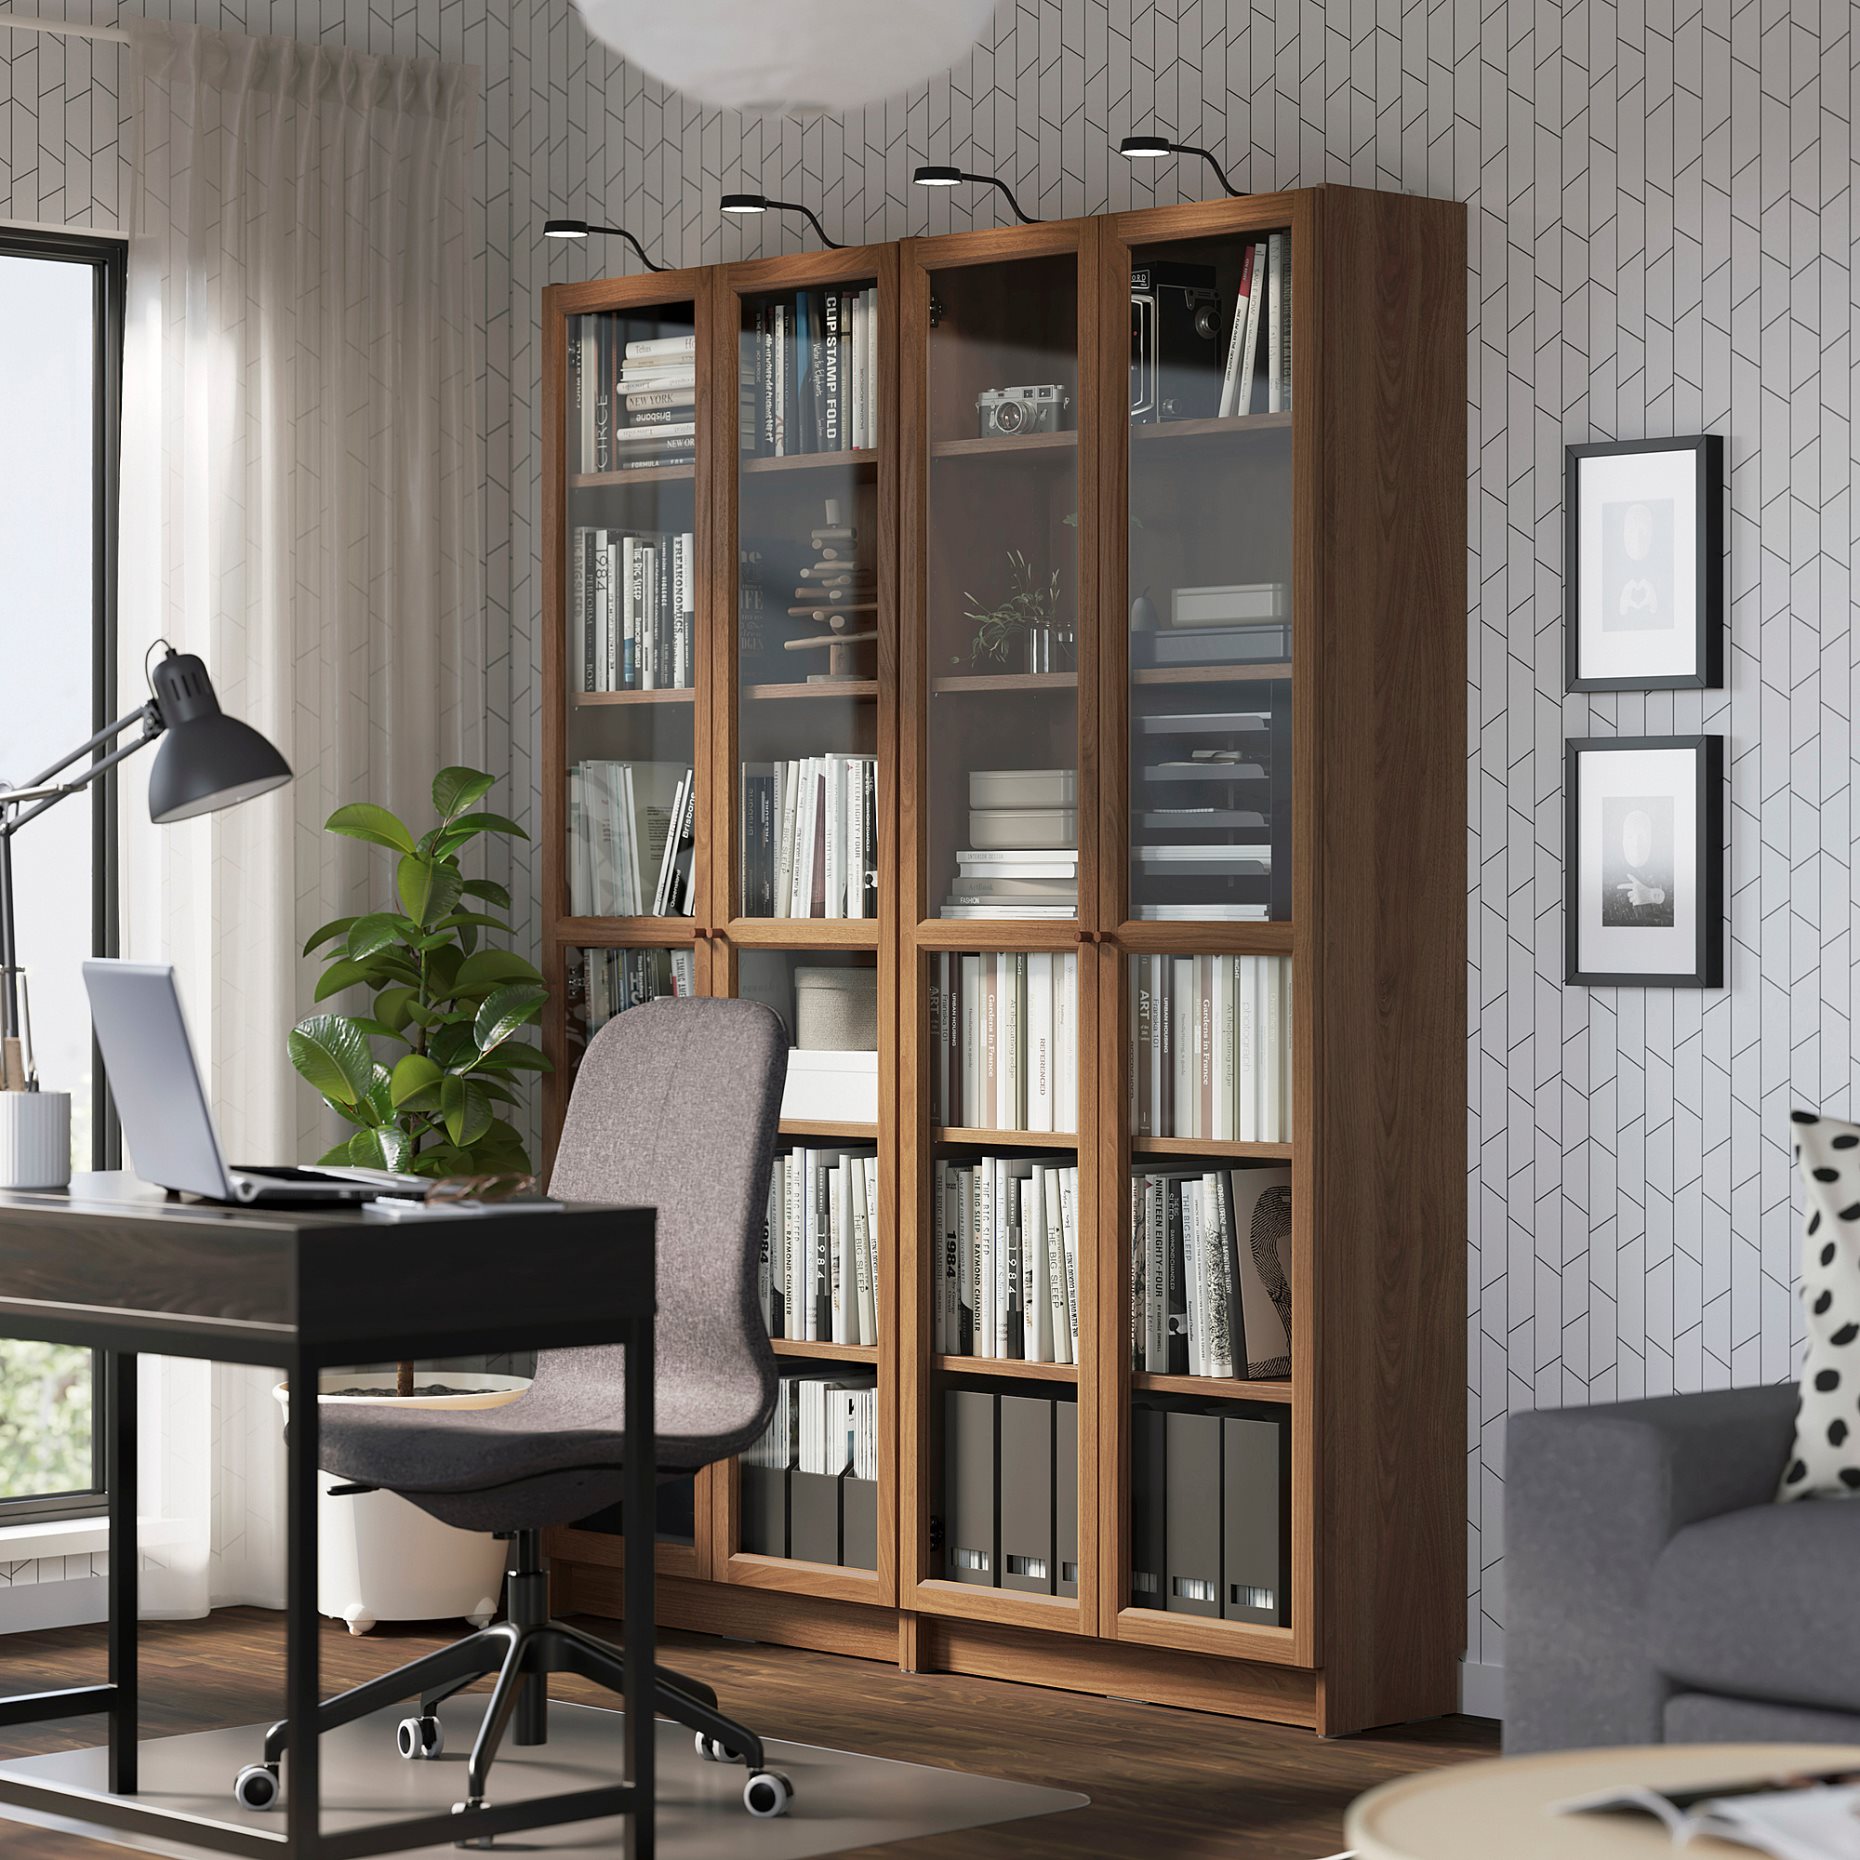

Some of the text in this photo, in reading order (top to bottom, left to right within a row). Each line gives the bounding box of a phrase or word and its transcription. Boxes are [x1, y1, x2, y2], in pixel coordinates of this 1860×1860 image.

[826, 297, 836, 438] CLIP STAMP FOLD
[1283, 335, 1291, 399] HEMINGWAY
[630, 394, 674, 407] NEW YORK
[597, 395, 608, 468] CIRCE
[636, 411, 671, 422] Brisbane
[667, 439, 682, 448] NEW
[595, 549, 608, 592] 1984
[633, 547, 642, 600] THE BIG SLEEP
[675, 540, 683, 633] FREAKONOMICS
[682, 791, 695, 839] Brisbane
[780, 846, 789, 874] SLEEP
[669, 869, 681, 908] Queensland
[676, 957, 686, 982] TAMING
[930, 986, 939, 1014] ART
[1010, 999, 1016, 1010] At
[1140, 990, 1149, 1020] ART
[1226, 1003, 1233, 1015] At
[988, 1034, 995, 1044] in
[1203, 1041, 1210, 1050] in
[1242, 1002, 1252, 1072] photograph
[936, 1216, 943, 1227] OF
[1048, 1226, 1056, 1246] THE
[946, 1231, 957, 1279] 1984
[1008, 1246, 1017, 1294] 1984
[1155, 1230, 1163, 1298] EIGHTY-FOUR
[857, 1260, 865, 1293] SLEEP
[1051, 1274, 1059, 1309] SLEEP
[1224, 1274, 1232, 1294] THEORY
